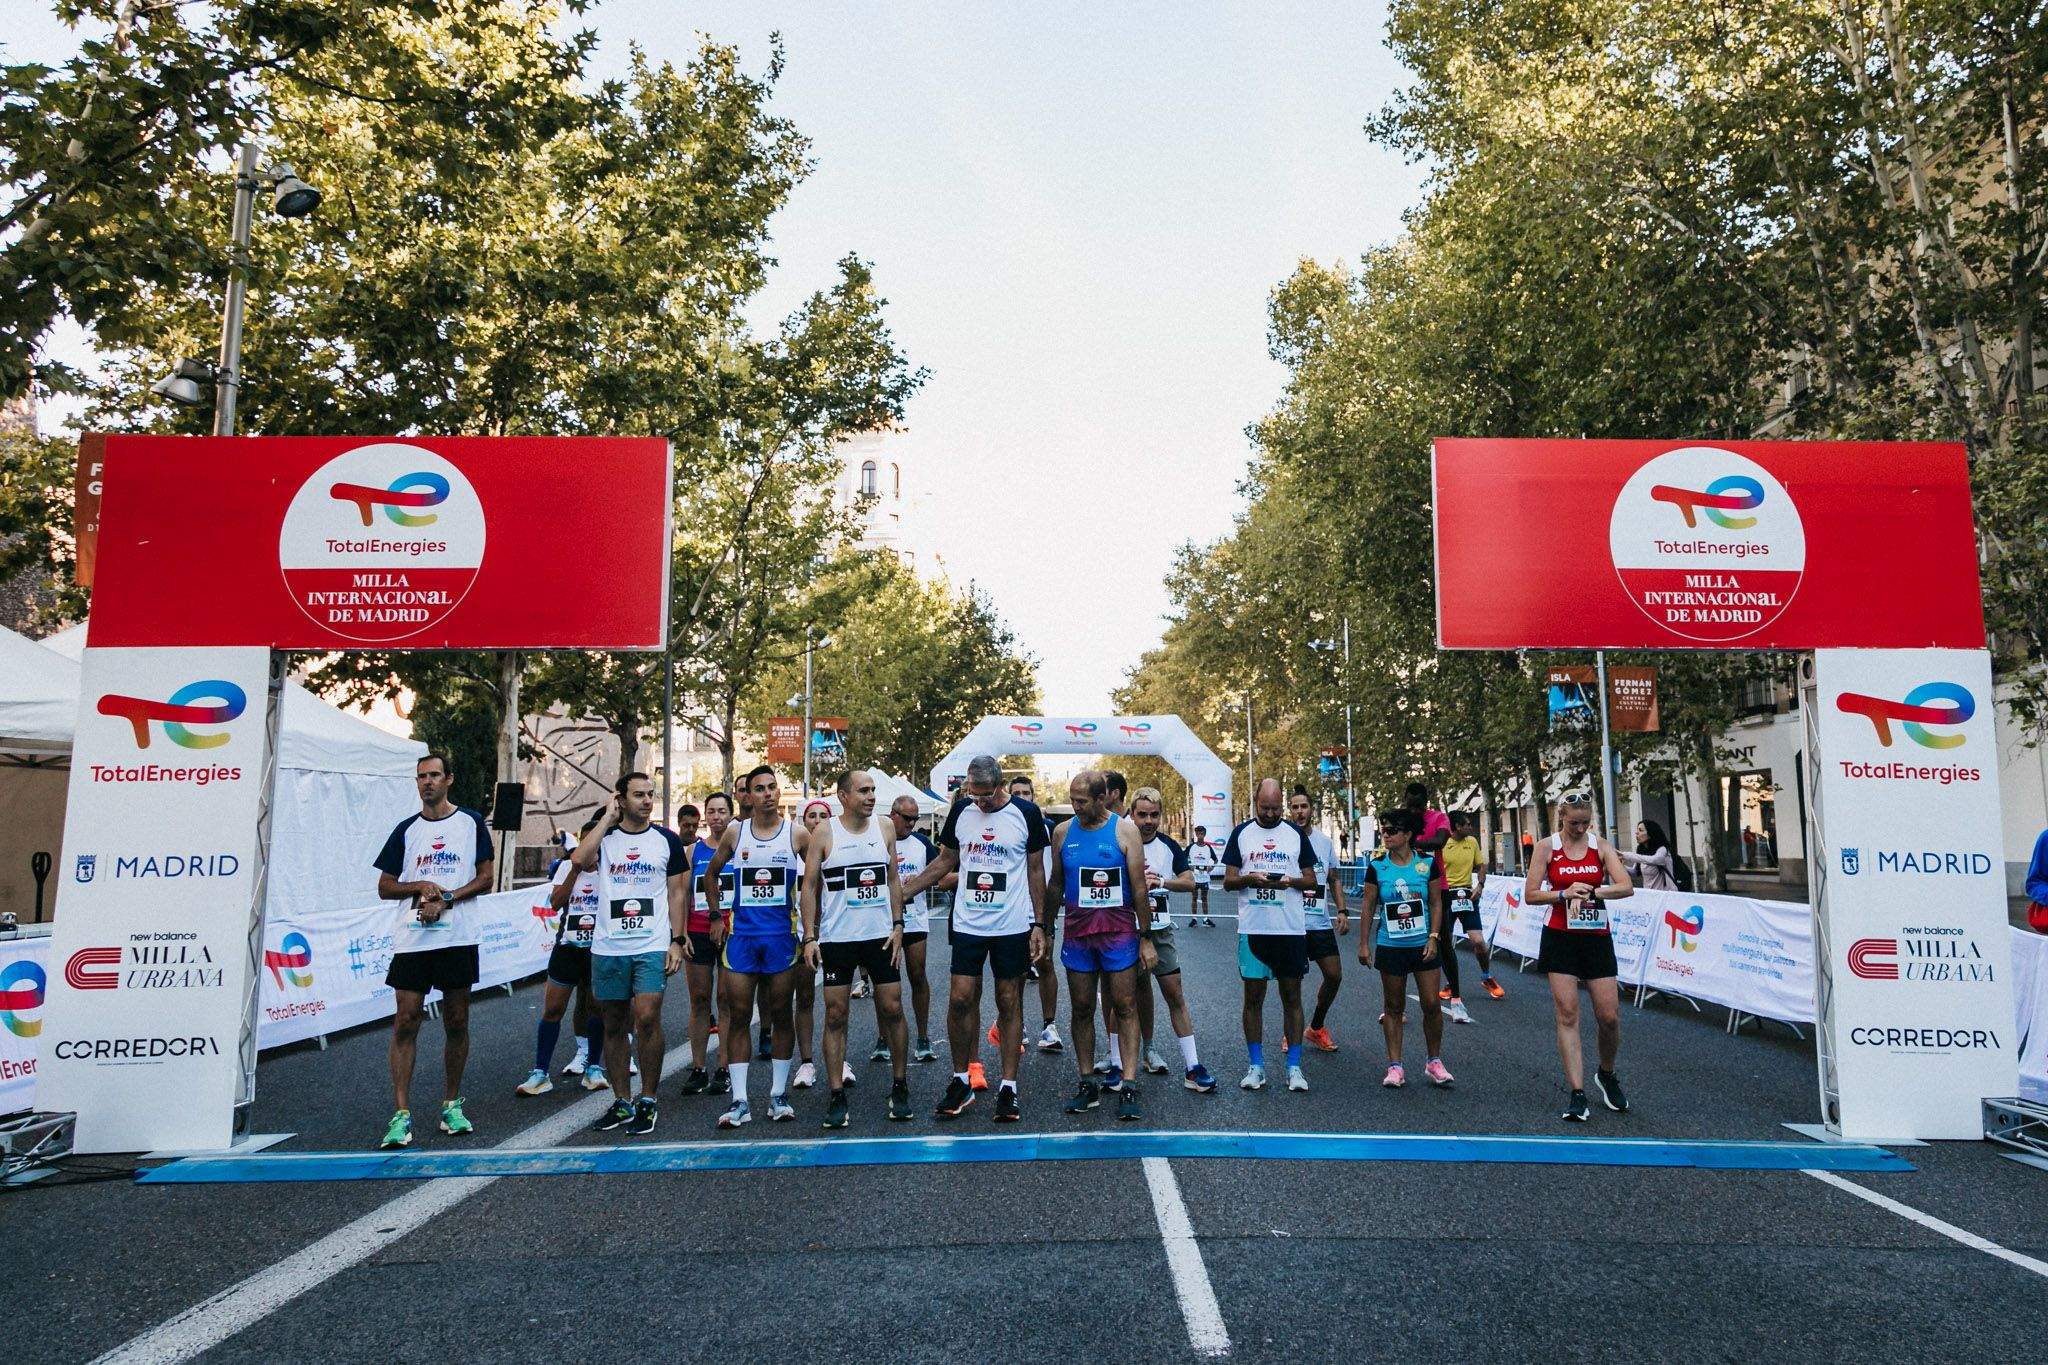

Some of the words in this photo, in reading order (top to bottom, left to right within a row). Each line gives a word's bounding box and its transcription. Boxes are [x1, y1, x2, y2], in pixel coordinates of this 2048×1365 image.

[326, 539, 446, 556] TotalEnergies
[1654, 541, 1769, 558] TotalEnergies
[352, 574, 410, 587] MILLA
[1685, 575, 1740, 588] MILLA
[328, 609, 353, 622] DE
[358, 609, 430, 622] MADRID
[1666, 609, 1690, 622] DE
[1694, 609, 1761, 622] MADRID
[1551, 674, 1571, 682] ISLA
[91, 763, 241, 785] TotalEnergies
[1840, 761, 1980, 785] TotalEnergies
[116, 855, 239, 878] MADRID
[1878, 851, 1991, 875] MADRID
[1559, 866, 1598, 875] POLAND
[752, 886, 774, 898] 533
[857, 887, 878, 899] 538
[975, 891, 994, 903] 537
[1090, 888, 1110, 899] 549
[1256, 889, 1276, 900] 558
[1580, 910, 1599, 921] 550
[621, 917, 644, 930] 562
[1397, 919, 1416, 930] 561
[130, 933, 151, 941] new
[154, 932, 197, 941] balance
[1903, 927, 1922, 935] new
[1924, 926, 1964, 936] balance
[130, 945, 213, 965] MILLA
[1905, 940, 1981, 959] MILLA
[126, 968, 223, 989] URBANA
[1906, 963, 1995, 982] URBANA
[266, 999, 326, 1021] TotalEnergies
